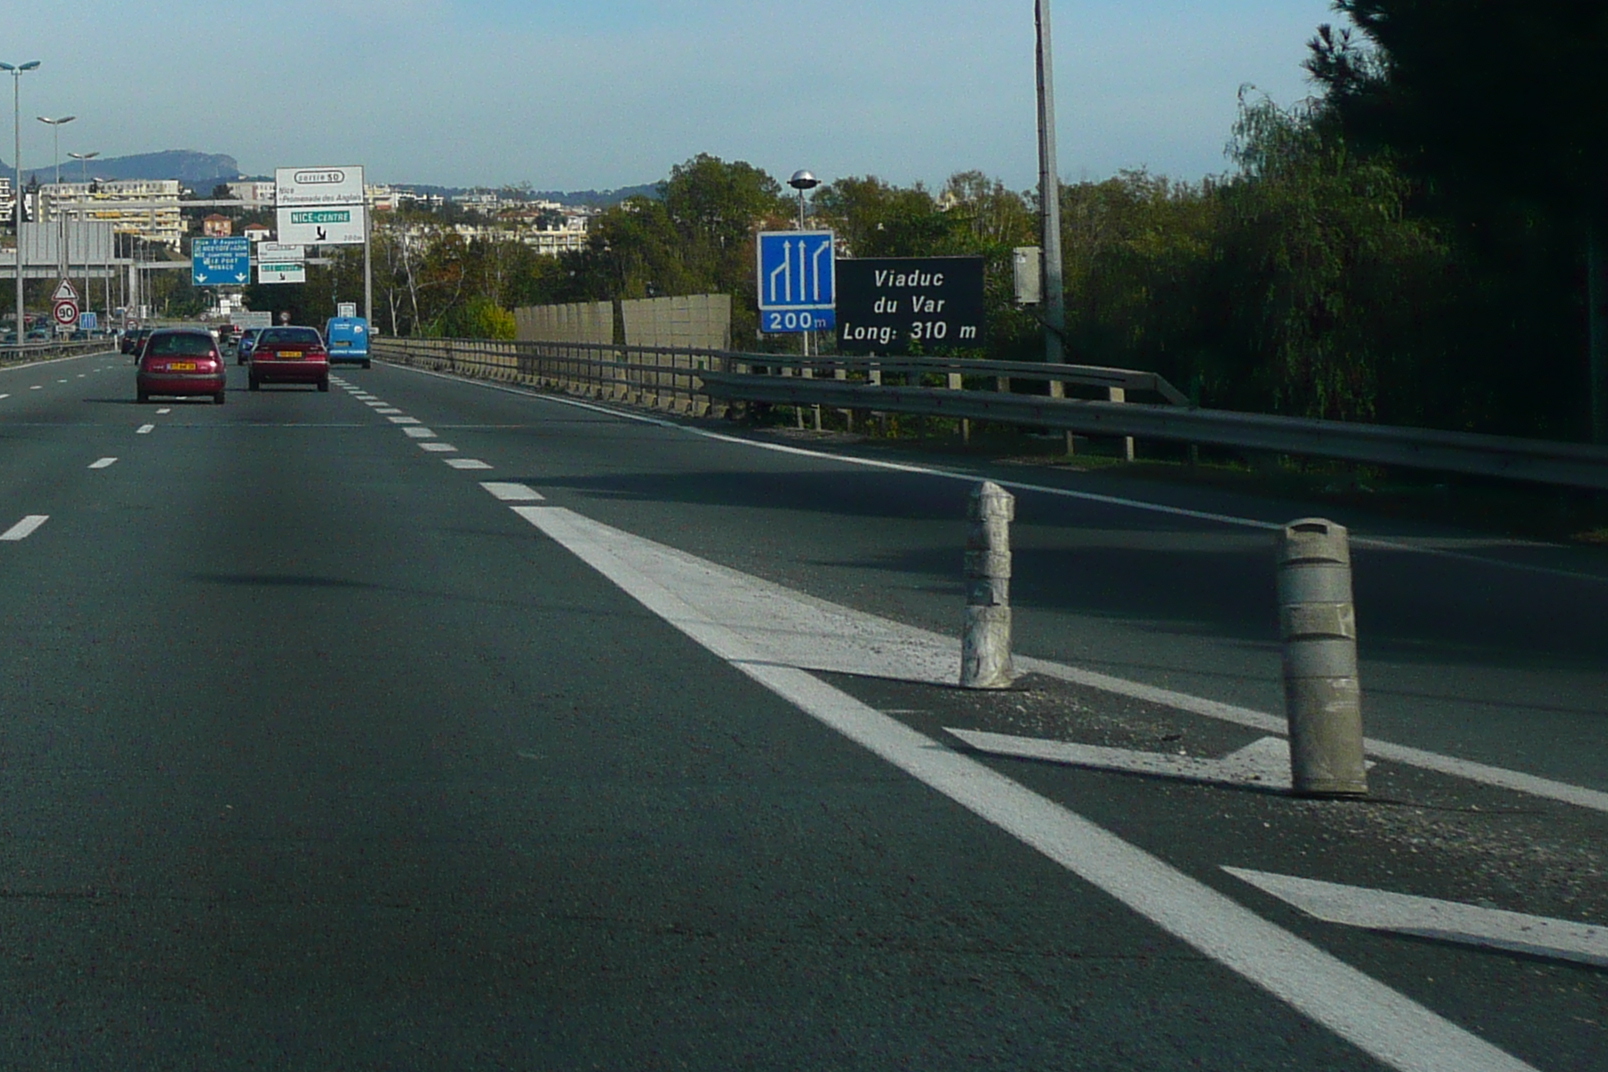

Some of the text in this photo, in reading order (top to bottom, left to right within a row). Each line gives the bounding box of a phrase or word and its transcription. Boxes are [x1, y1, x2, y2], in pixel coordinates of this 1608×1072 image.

[874, 269, 944, 288] Viaduc
[59, 307, 74, 318] 90
[873, 295, 946, 314] du Var
[843, 320, 977, 345] Long: 310 m
